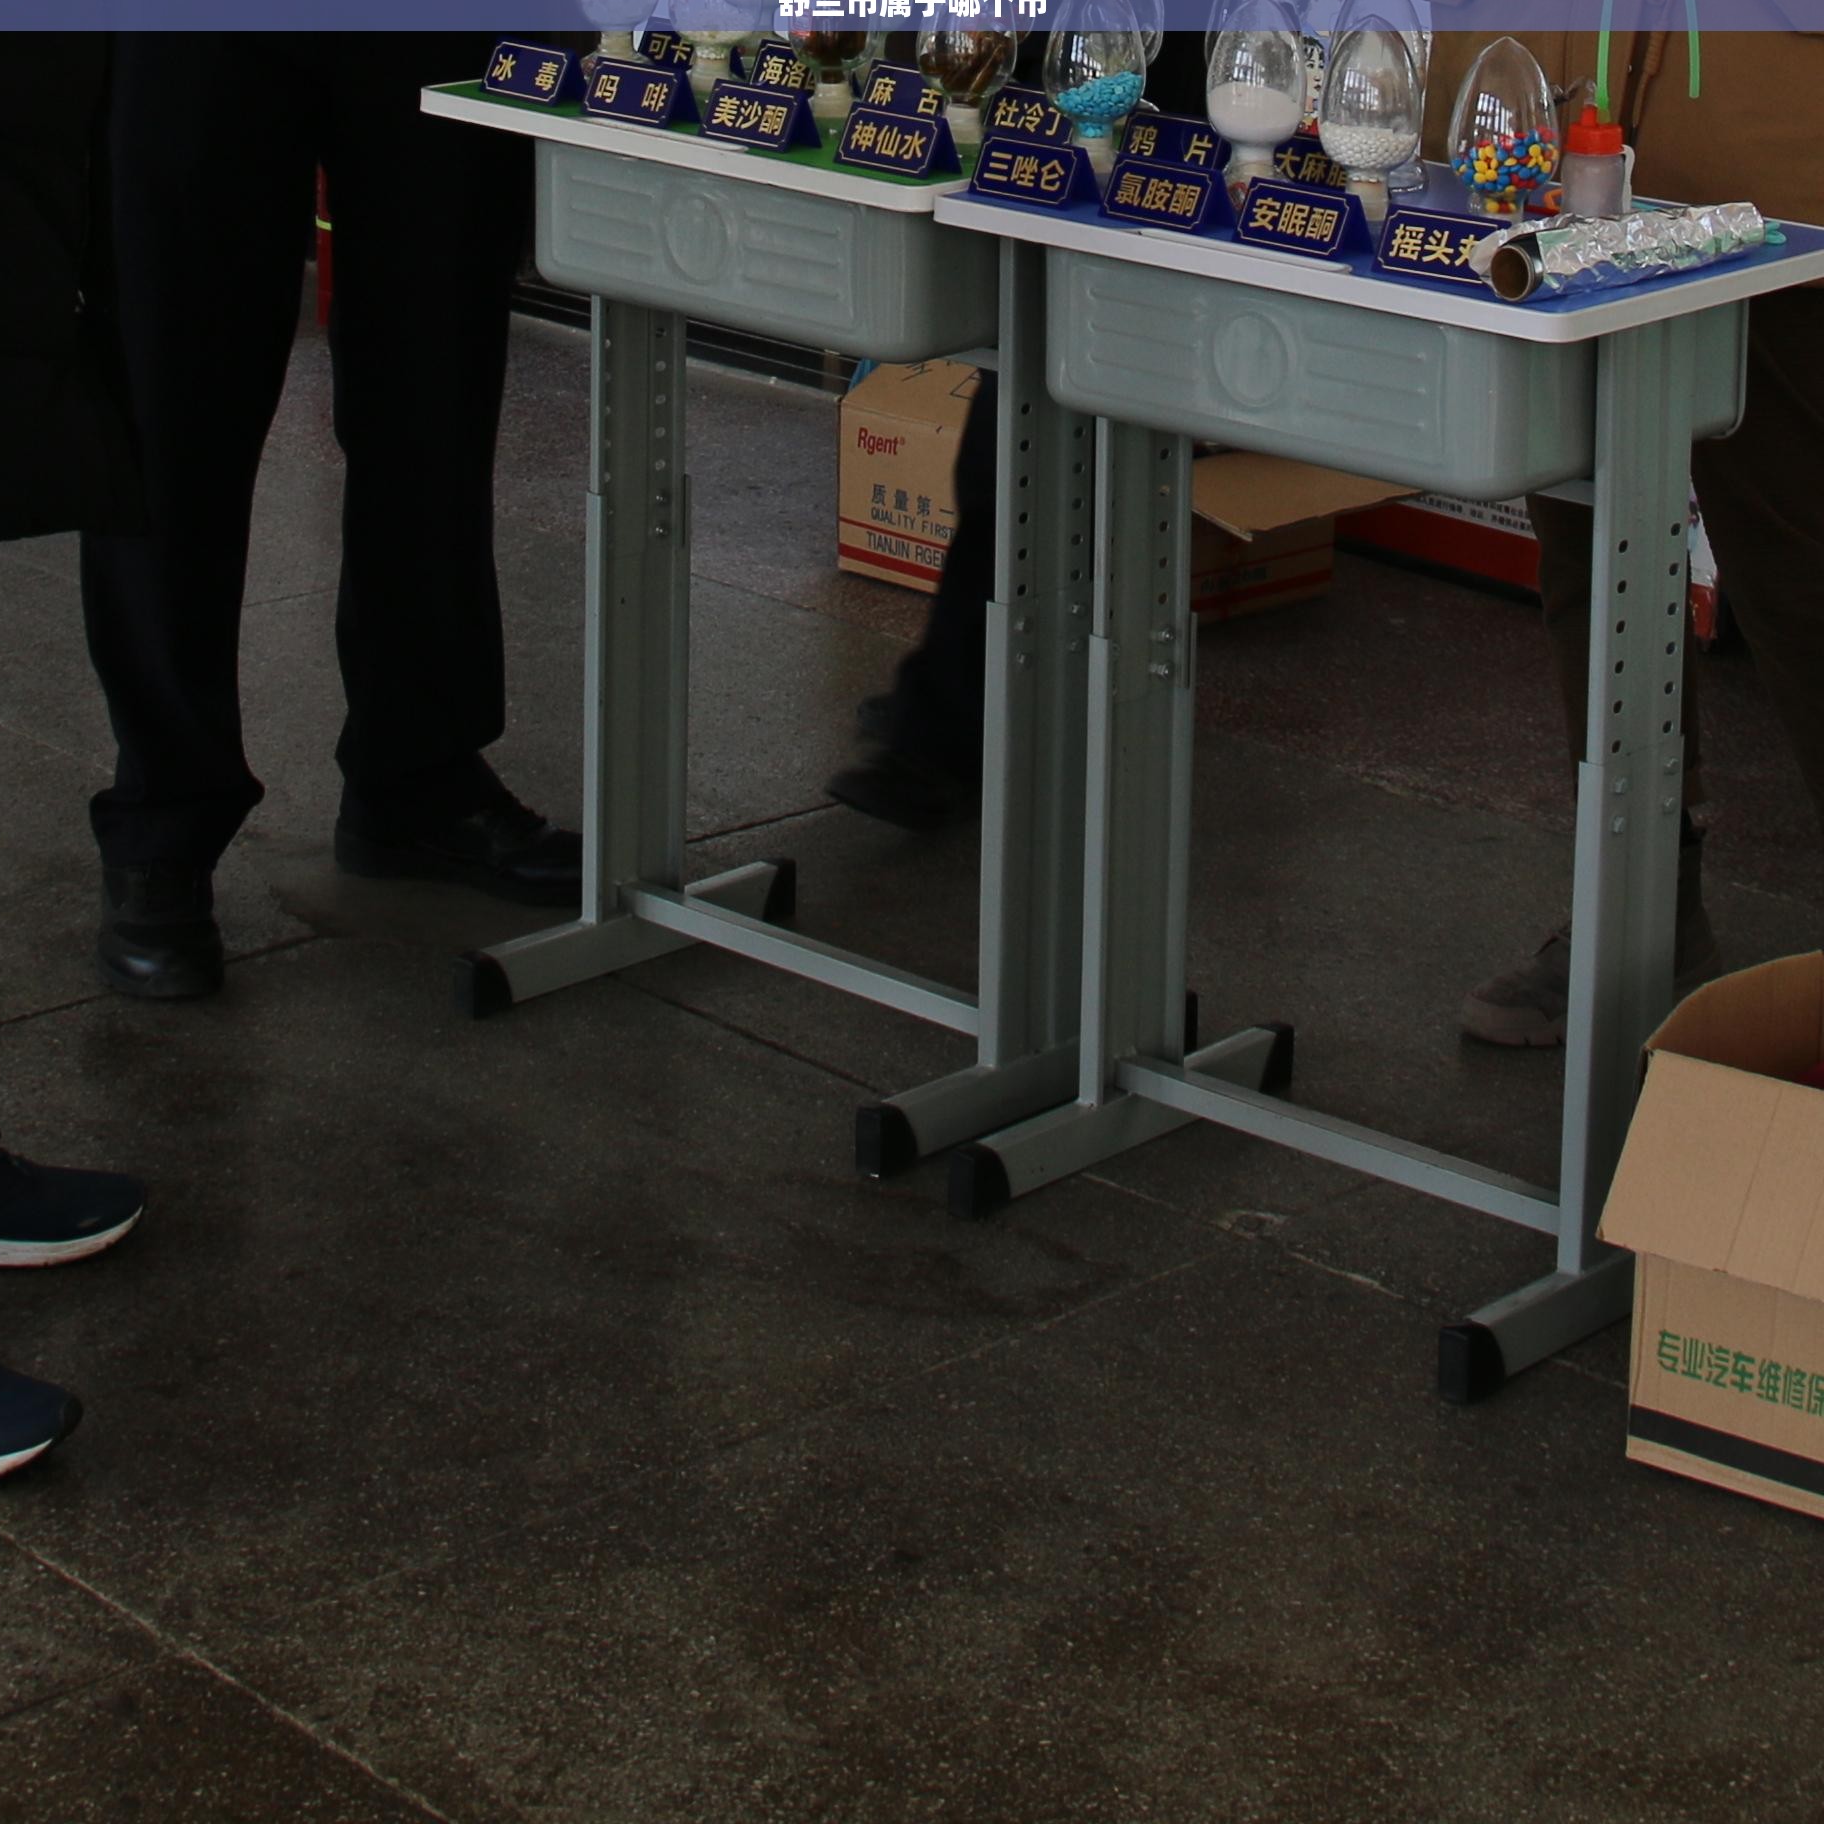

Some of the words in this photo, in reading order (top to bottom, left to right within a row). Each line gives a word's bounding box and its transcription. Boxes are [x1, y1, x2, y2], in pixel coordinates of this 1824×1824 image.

[491, 53, 559, 92] 冰毒
[594, 75, 669, 113] 吗啡
[868, 76, 943, 115] 麻古
[711, 95, 789, 138] 美沙酮
[850, 118, 927, 162] 神仙水
[1127, 120, 1214, 167] 鸦片
[983, 149, 1065, 192] 三唑仑
[1114, 171, 1199, 218] 氯胺酮
[1252, 195, 1334, 244] 安眠酮
[857, 427, 898, 455] Rgent
[871, 483, 955, 516] 质量第一
[871, 508, 916, 531] QUALITY
[921, 521, 956, 539] FIRST
[866, 531, 910, 559] TIANJIN
